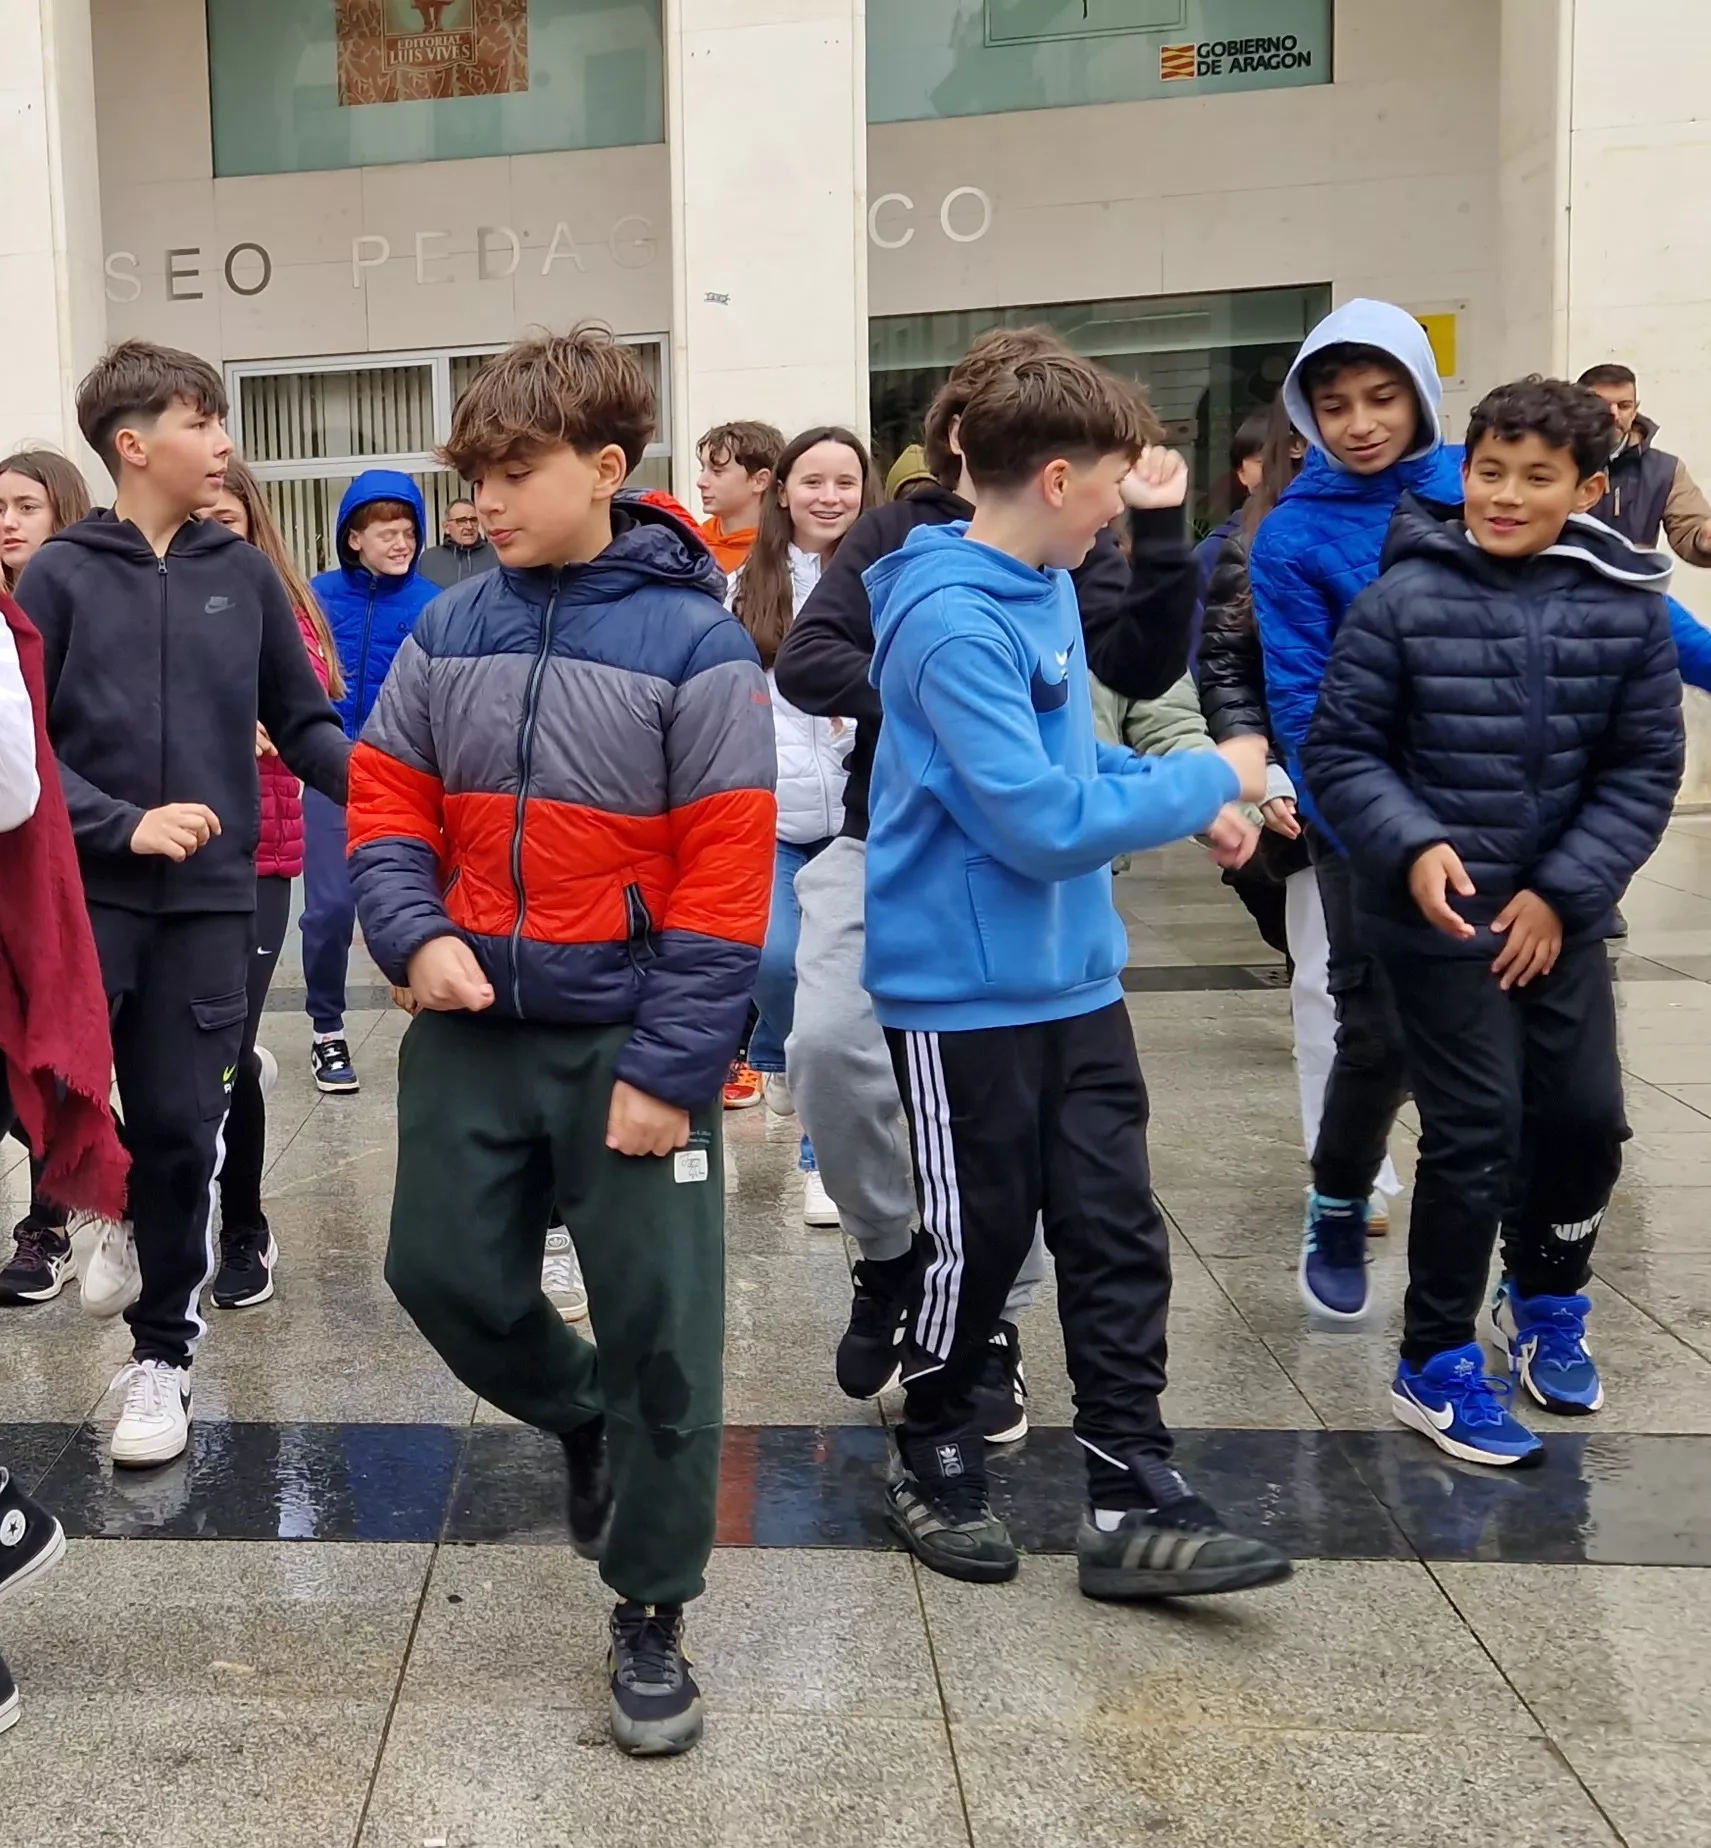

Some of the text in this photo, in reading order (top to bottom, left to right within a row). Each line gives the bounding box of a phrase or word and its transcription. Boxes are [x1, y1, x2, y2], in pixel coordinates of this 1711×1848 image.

[397, 35, 462, 49] EDITORIAL
[1196, 35, 1297, 59] GOBIERNO
[390, 44, 471, 65] LUIS VIVES
[1196, 59, 1222, 77] DE
